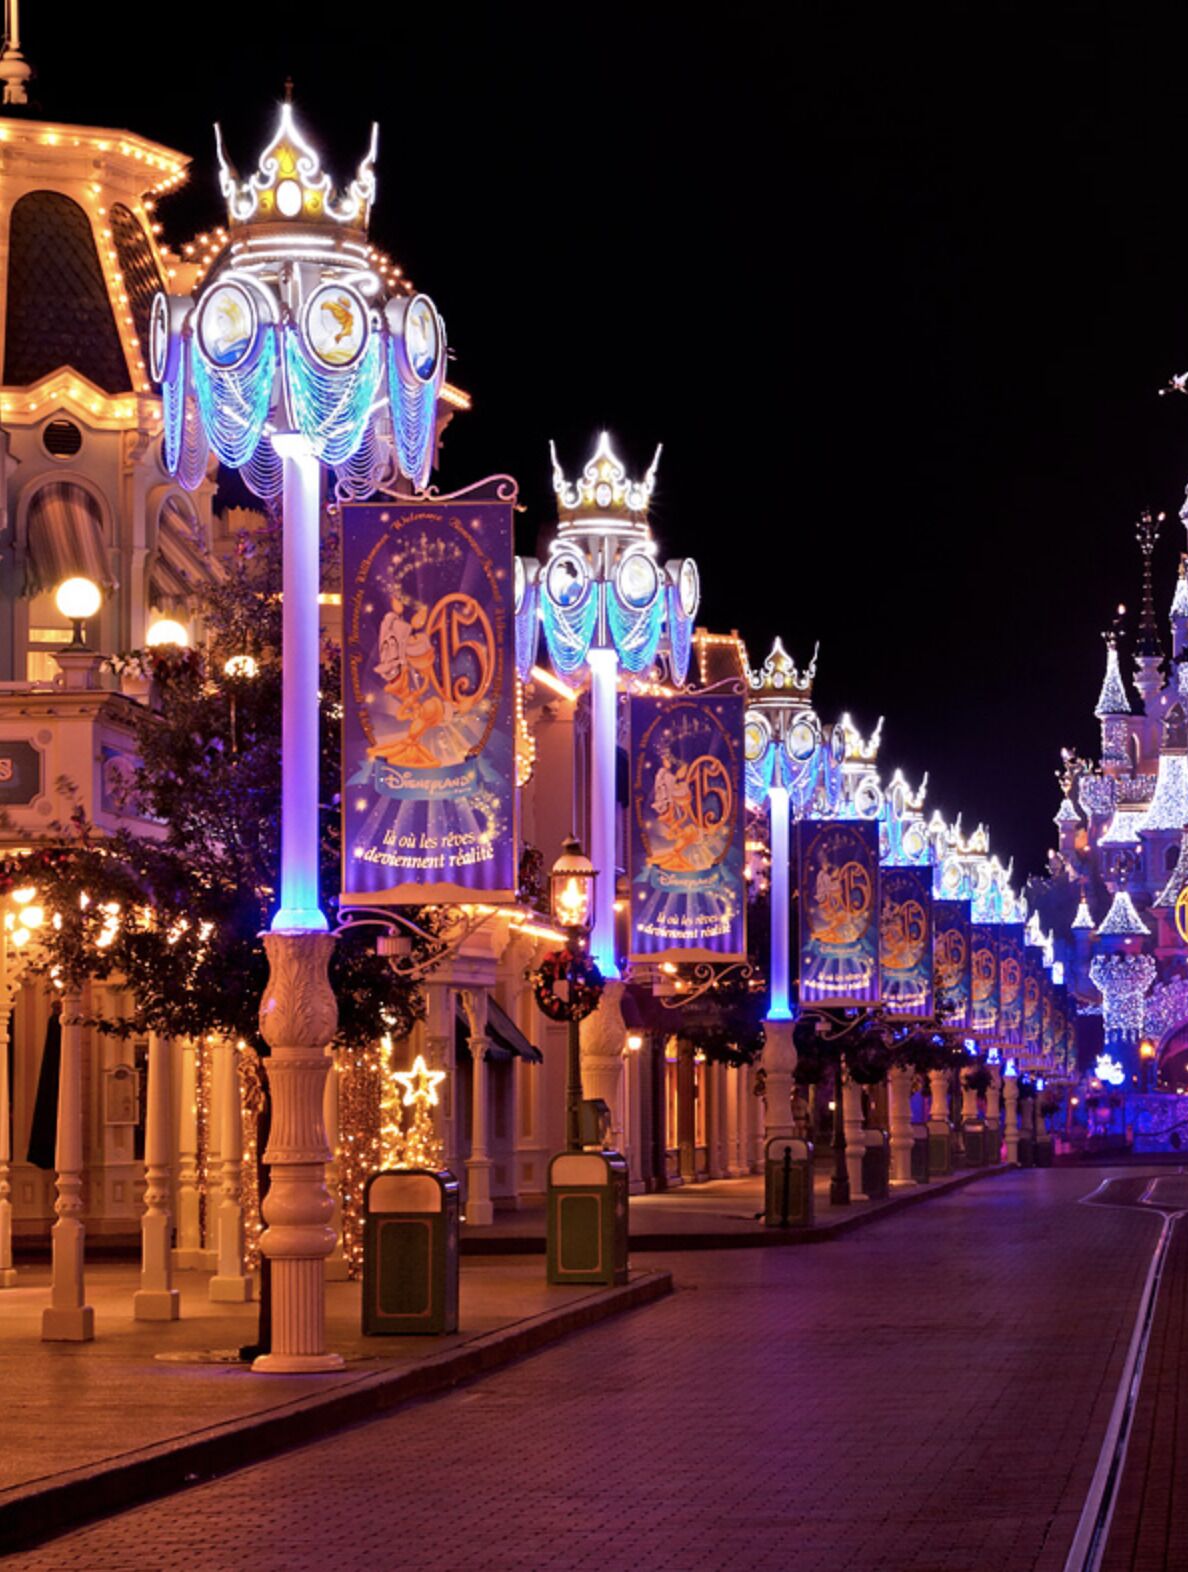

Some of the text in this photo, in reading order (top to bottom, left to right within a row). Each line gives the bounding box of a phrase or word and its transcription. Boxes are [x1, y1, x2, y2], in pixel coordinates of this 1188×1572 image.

[427, 592, 494, 706] 15
[687, 755, 732, 829] 15
[363, 847, 444, 869] deviennent
[382, 829, 397, 846] là
[399, 832, 416, 849] où
[419, 833, 437, 849] les
